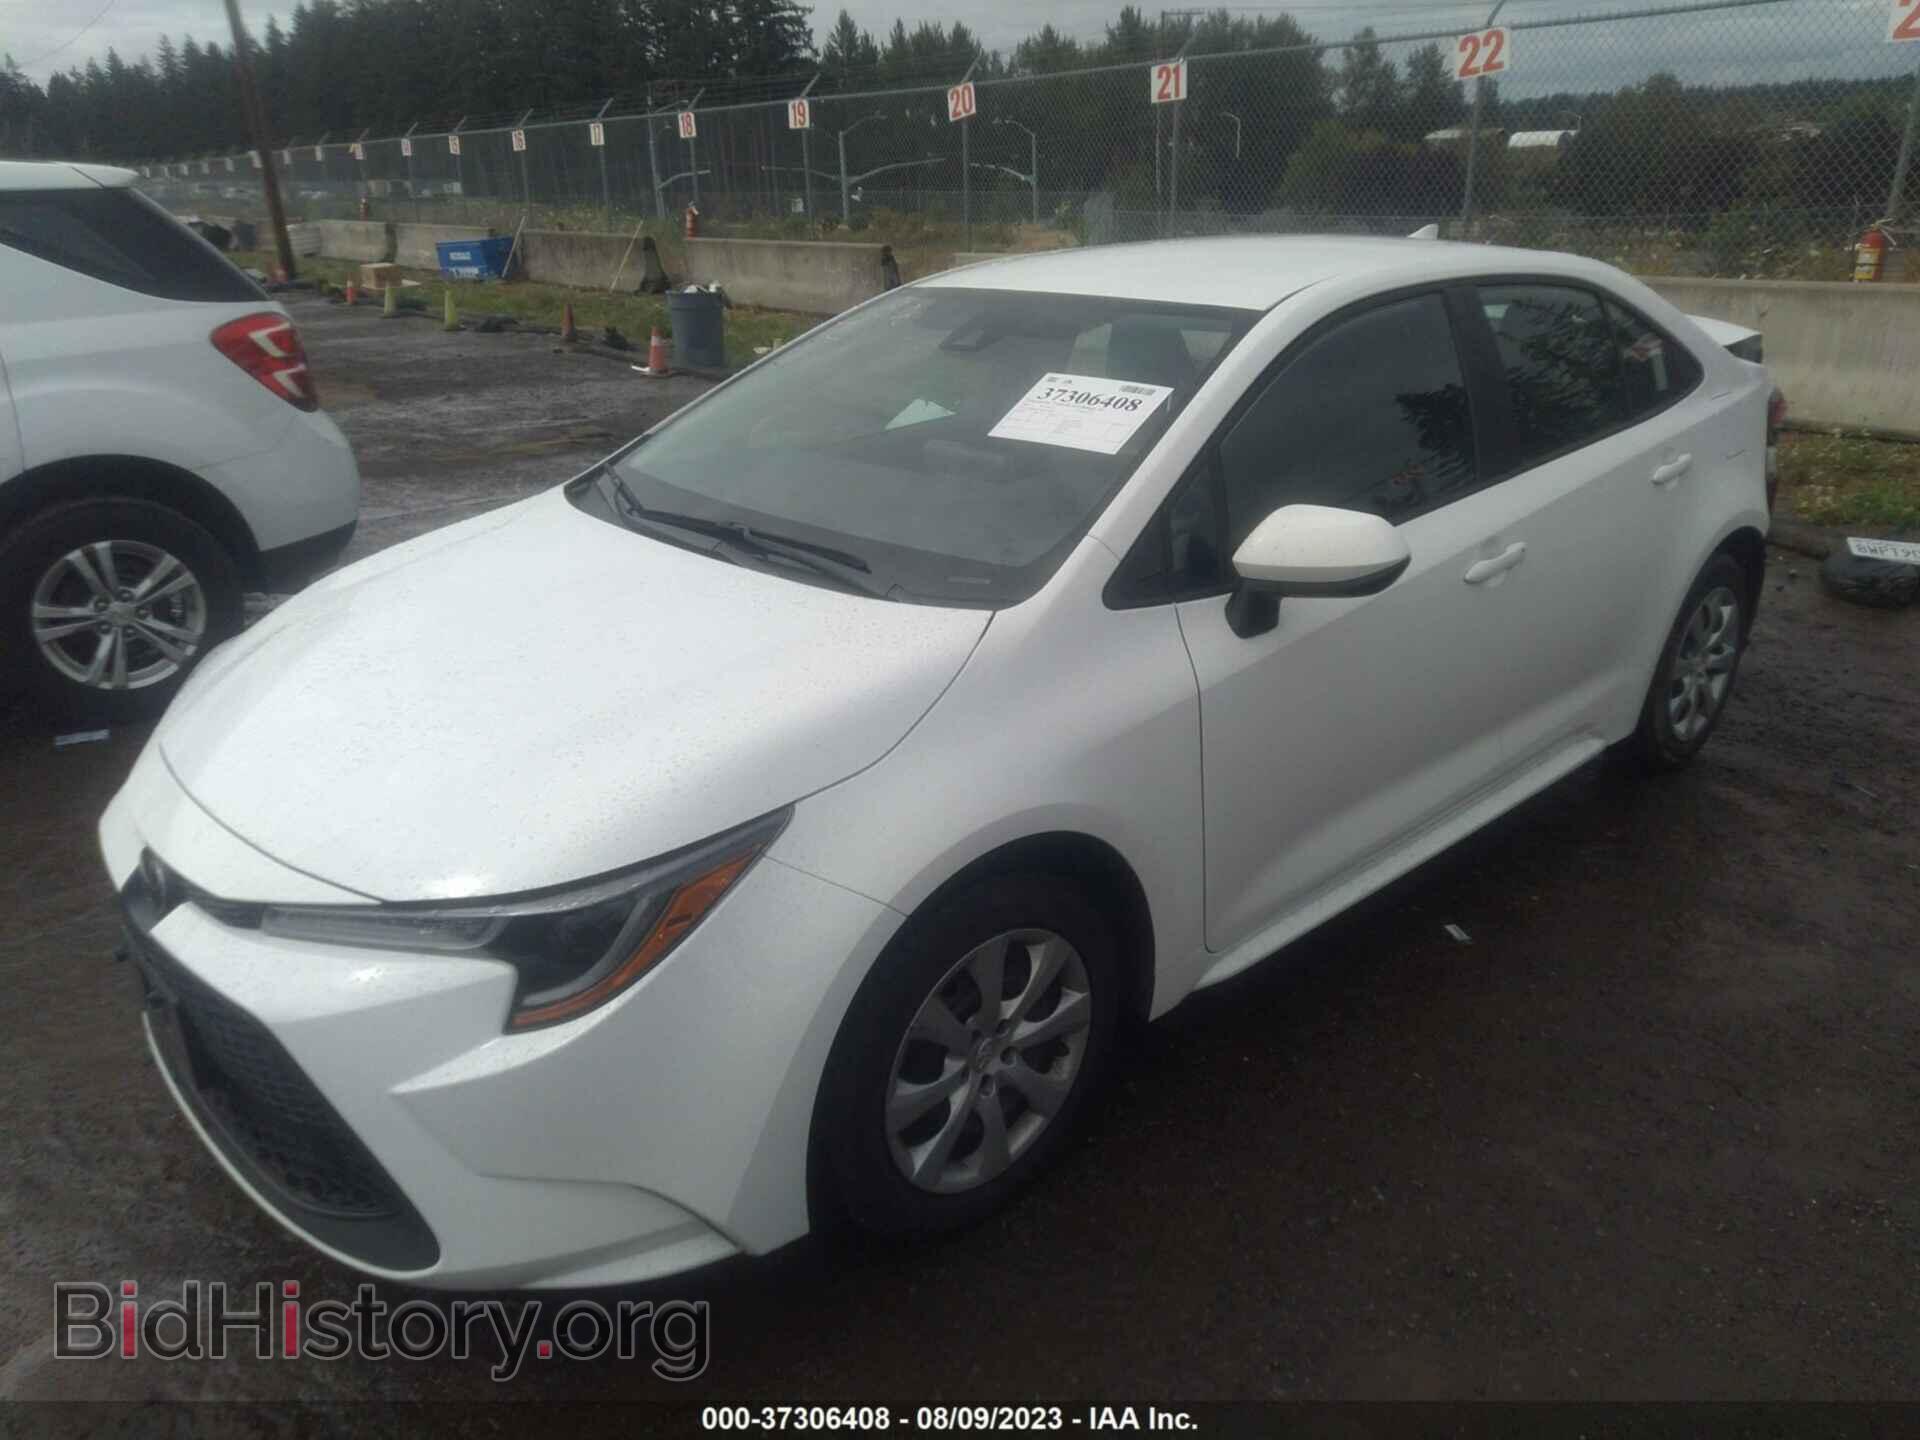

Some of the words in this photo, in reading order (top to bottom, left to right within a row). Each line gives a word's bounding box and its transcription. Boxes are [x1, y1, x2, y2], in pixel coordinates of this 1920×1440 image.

[1459, 30, 1504, 77] 22
[1157, 64, 1180, 99] 21
[791, 100, 806, 126] 19
[950, 84, 974, 118] 20
[682, 112, 693, 136] 18
[1037, 387, 1143, 412] 37306408
